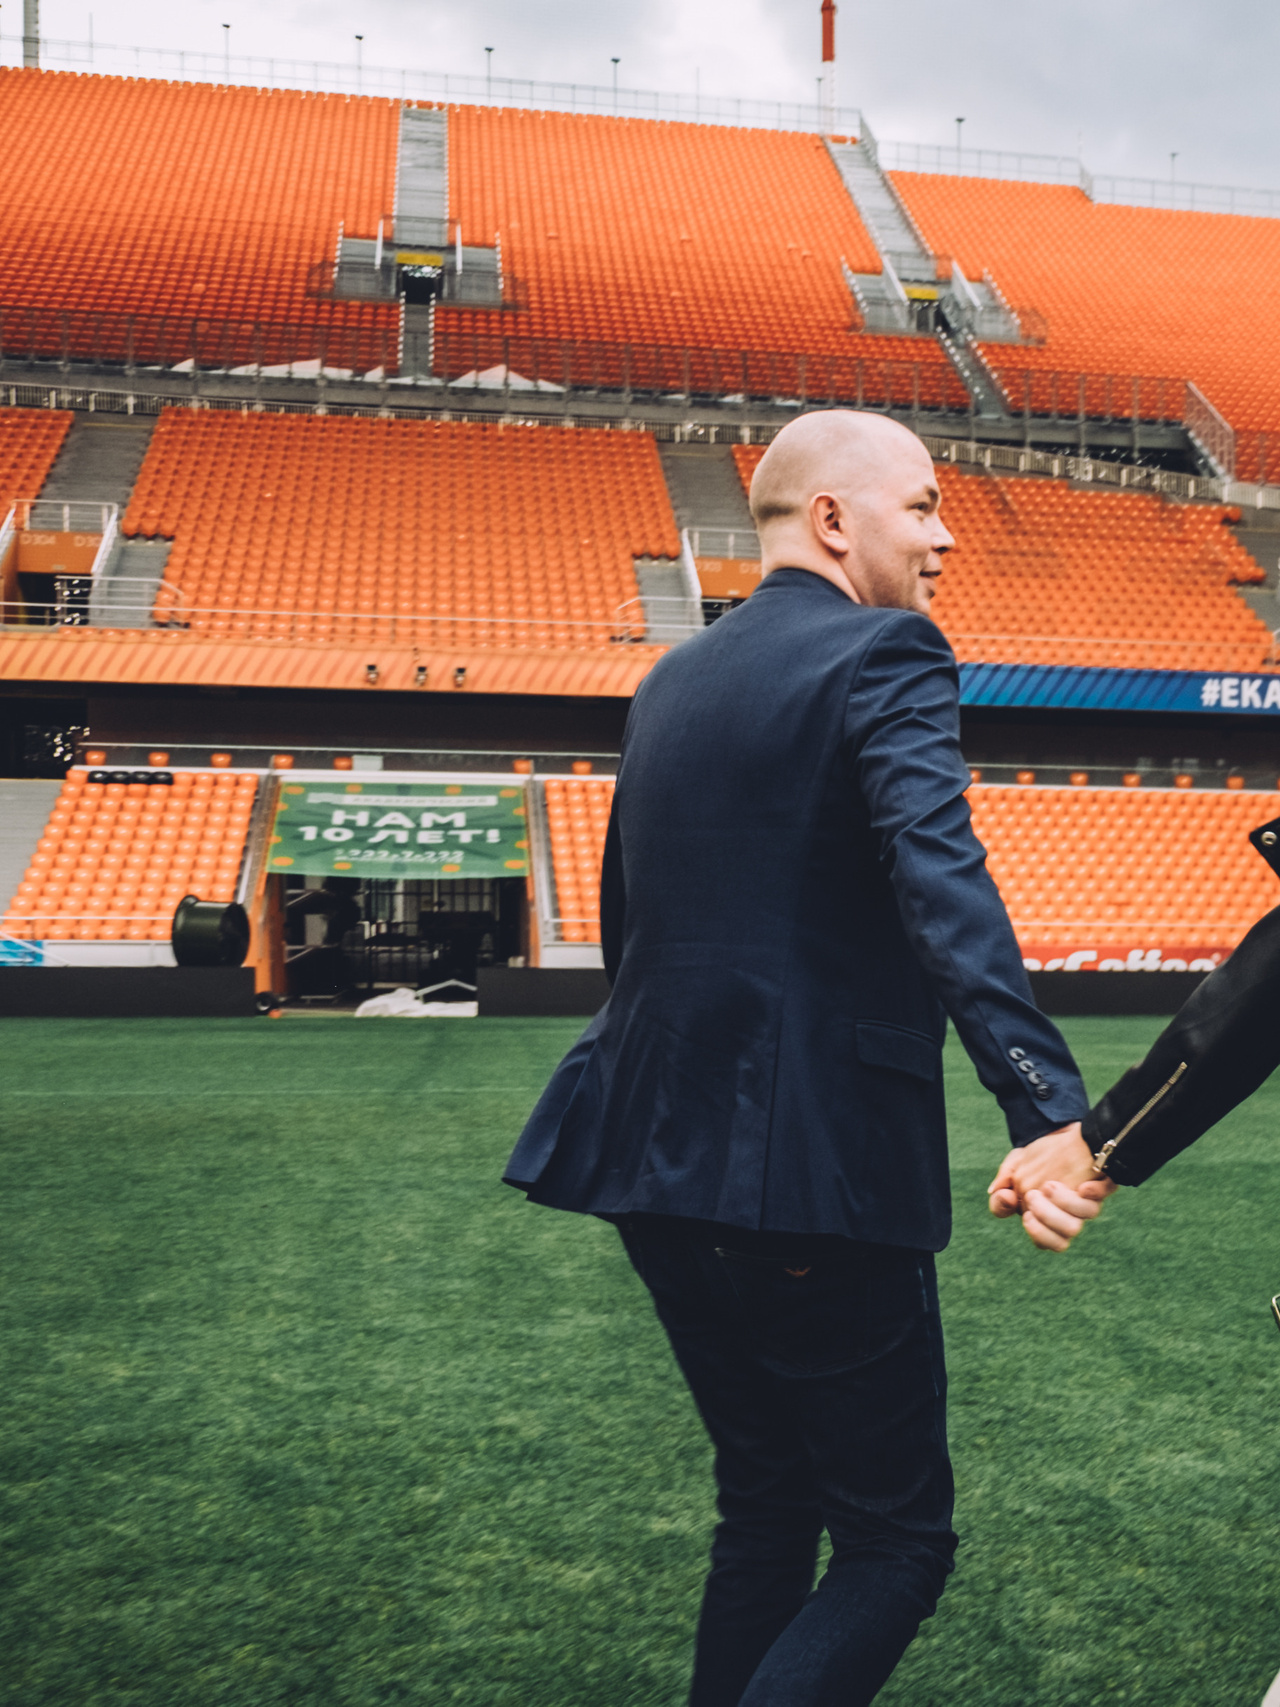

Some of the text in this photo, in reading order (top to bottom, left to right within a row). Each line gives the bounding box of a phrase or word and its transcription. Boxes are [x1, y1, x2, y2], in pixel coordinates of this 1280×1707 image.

[331, 809, 467, 829] НАМ
[298, 825, 500, 844] 10 ЛЕТ!
